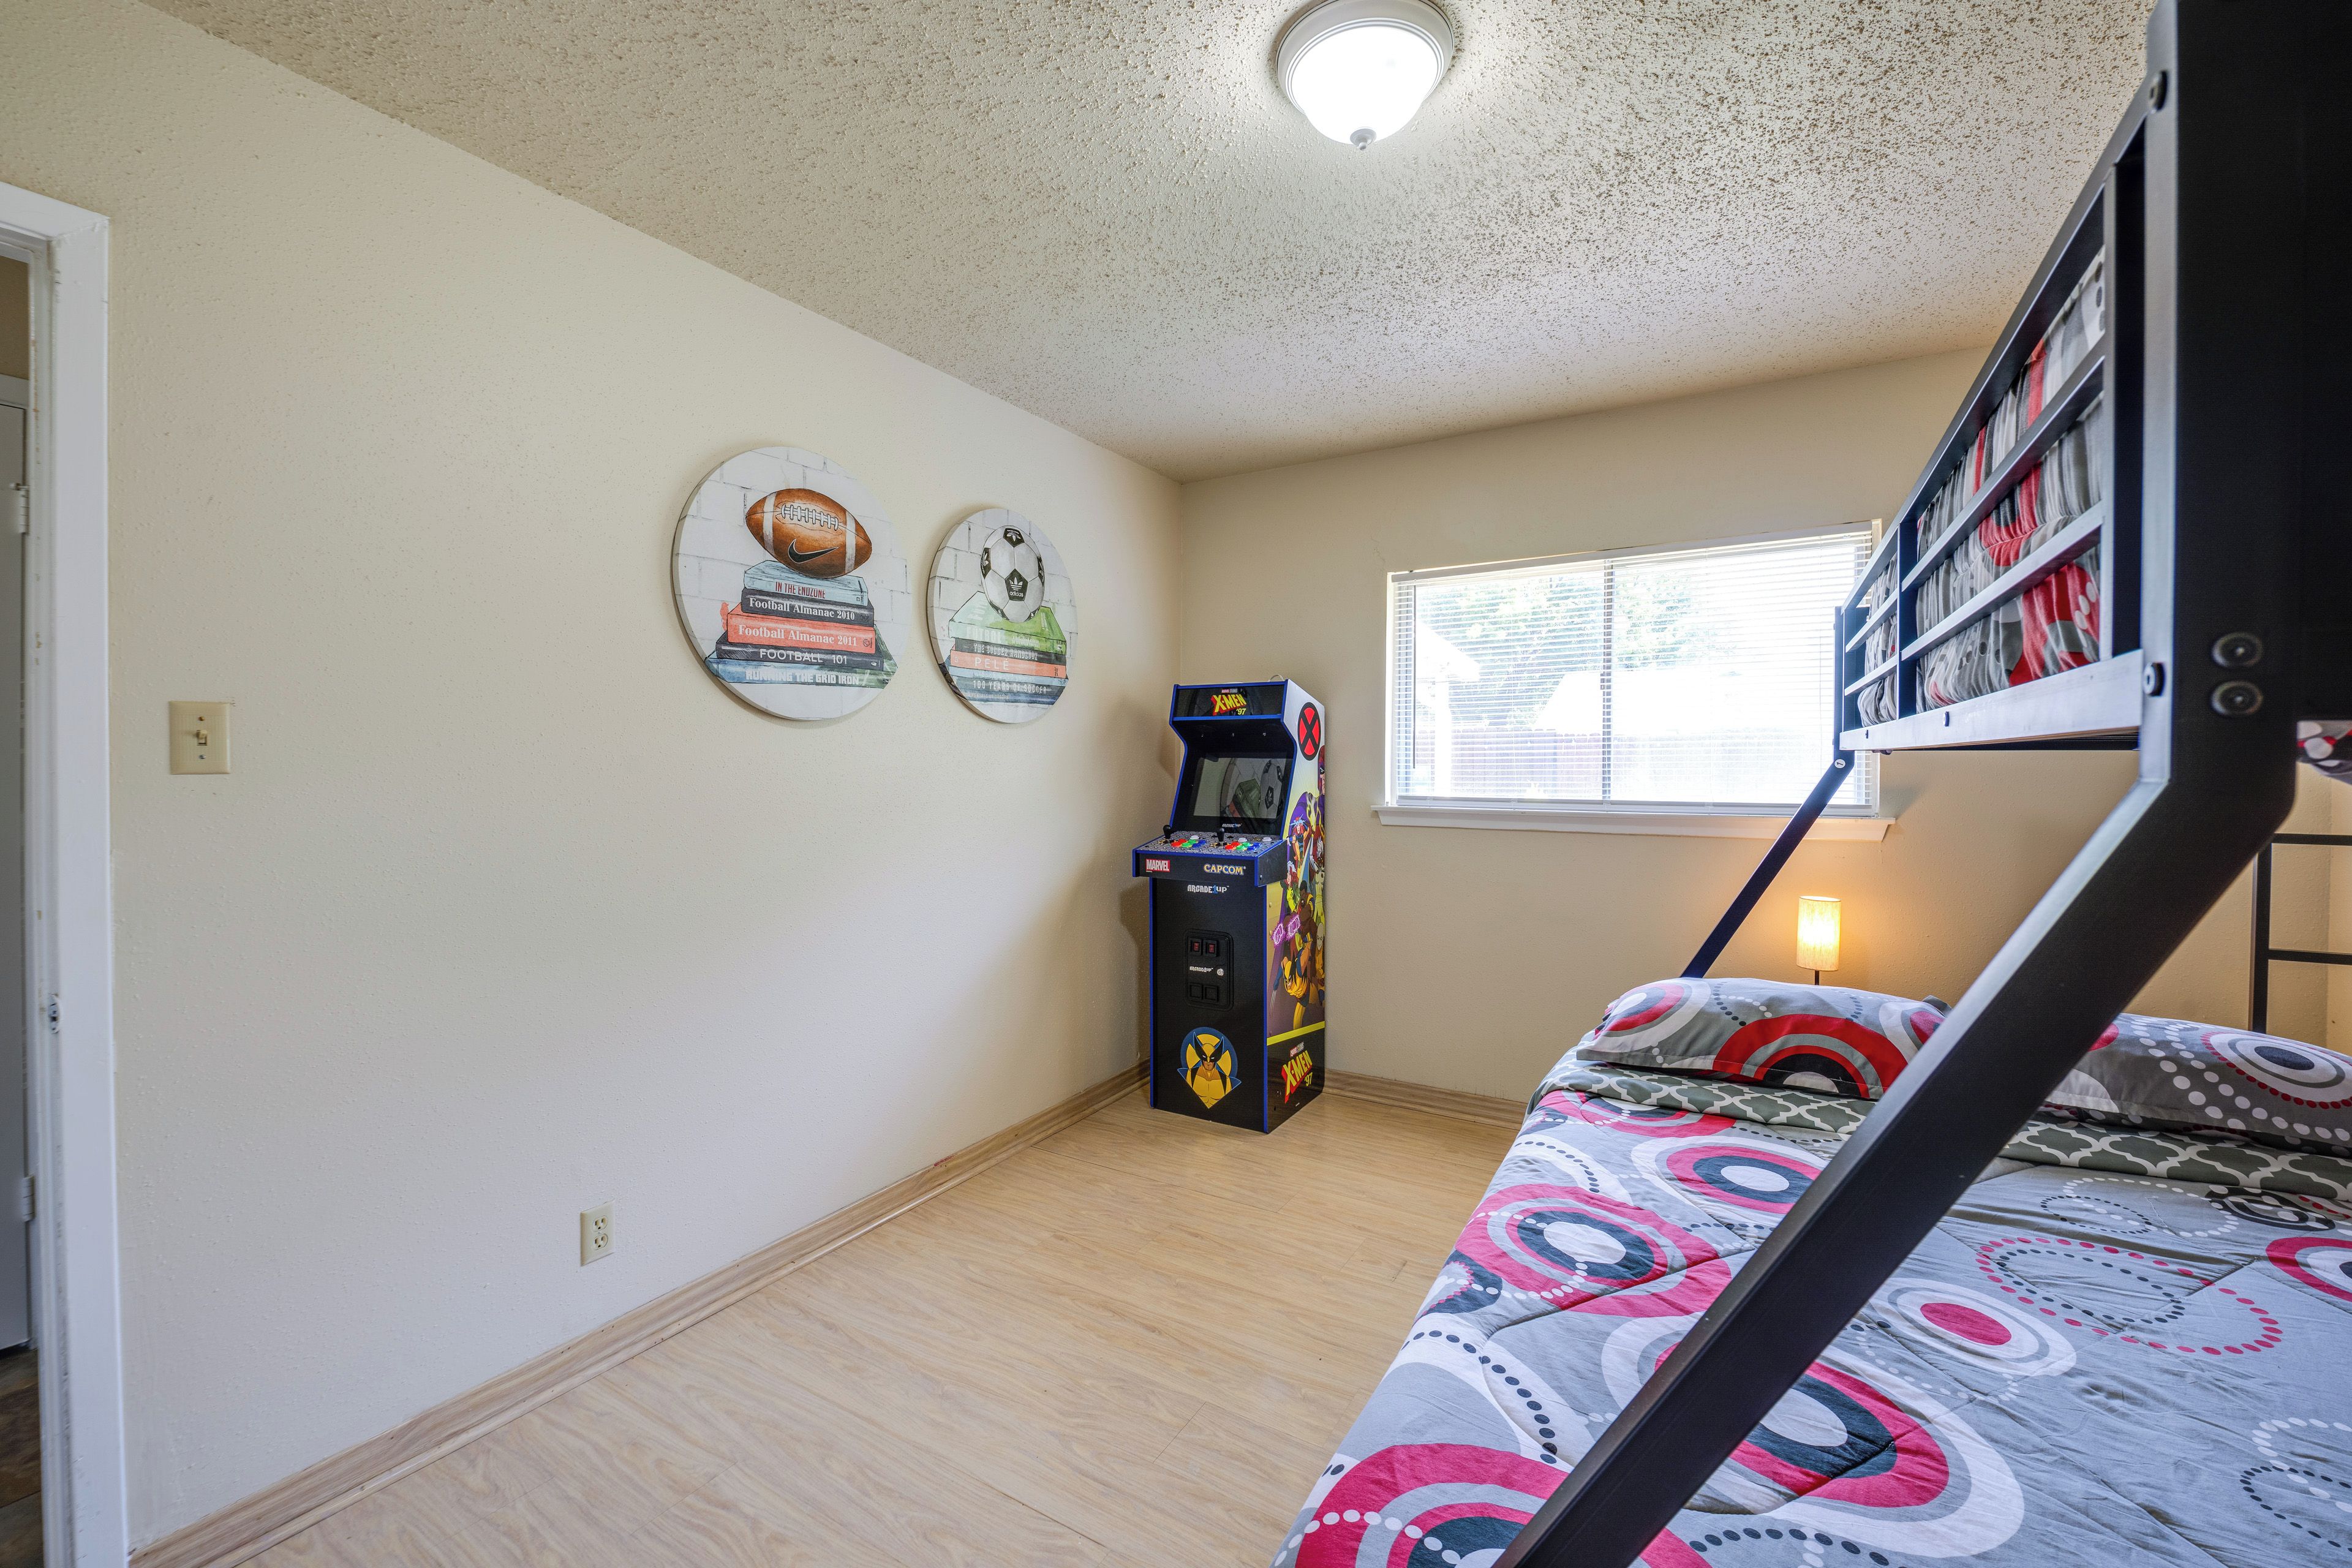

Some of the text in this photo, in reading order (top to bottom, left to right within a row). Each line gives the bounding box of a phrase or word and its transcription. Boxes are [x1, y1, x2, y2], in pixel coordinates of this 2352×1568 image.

[775, 581, 782, 592] IN
[785, 582, 796, 594] THE
[749, 597, 855, 620] Football Almanac 2010
[738, 624, 785, 639] Football
[788, 630, 834, 644] Almanac
[837, 635, 857, 647] 2011
[974, 643, 985, 653] THE
[760, 649, 847, 665] FOOTBALL 101
[974, 657, 1010, 671] PELÉ
[745, 668, 859, 685] RUNNING THE GRID IRON
[973, 680, 1047, 695] 100 YEARS OF SOCCER
[1211, 693, 1247, 715] X-MEN
[1147, 859, 1169, 871] MARVEL
[1204, 864, 1244, 875] CAPCOM
[1281, 1050, 1313, 1102] X-MEN
